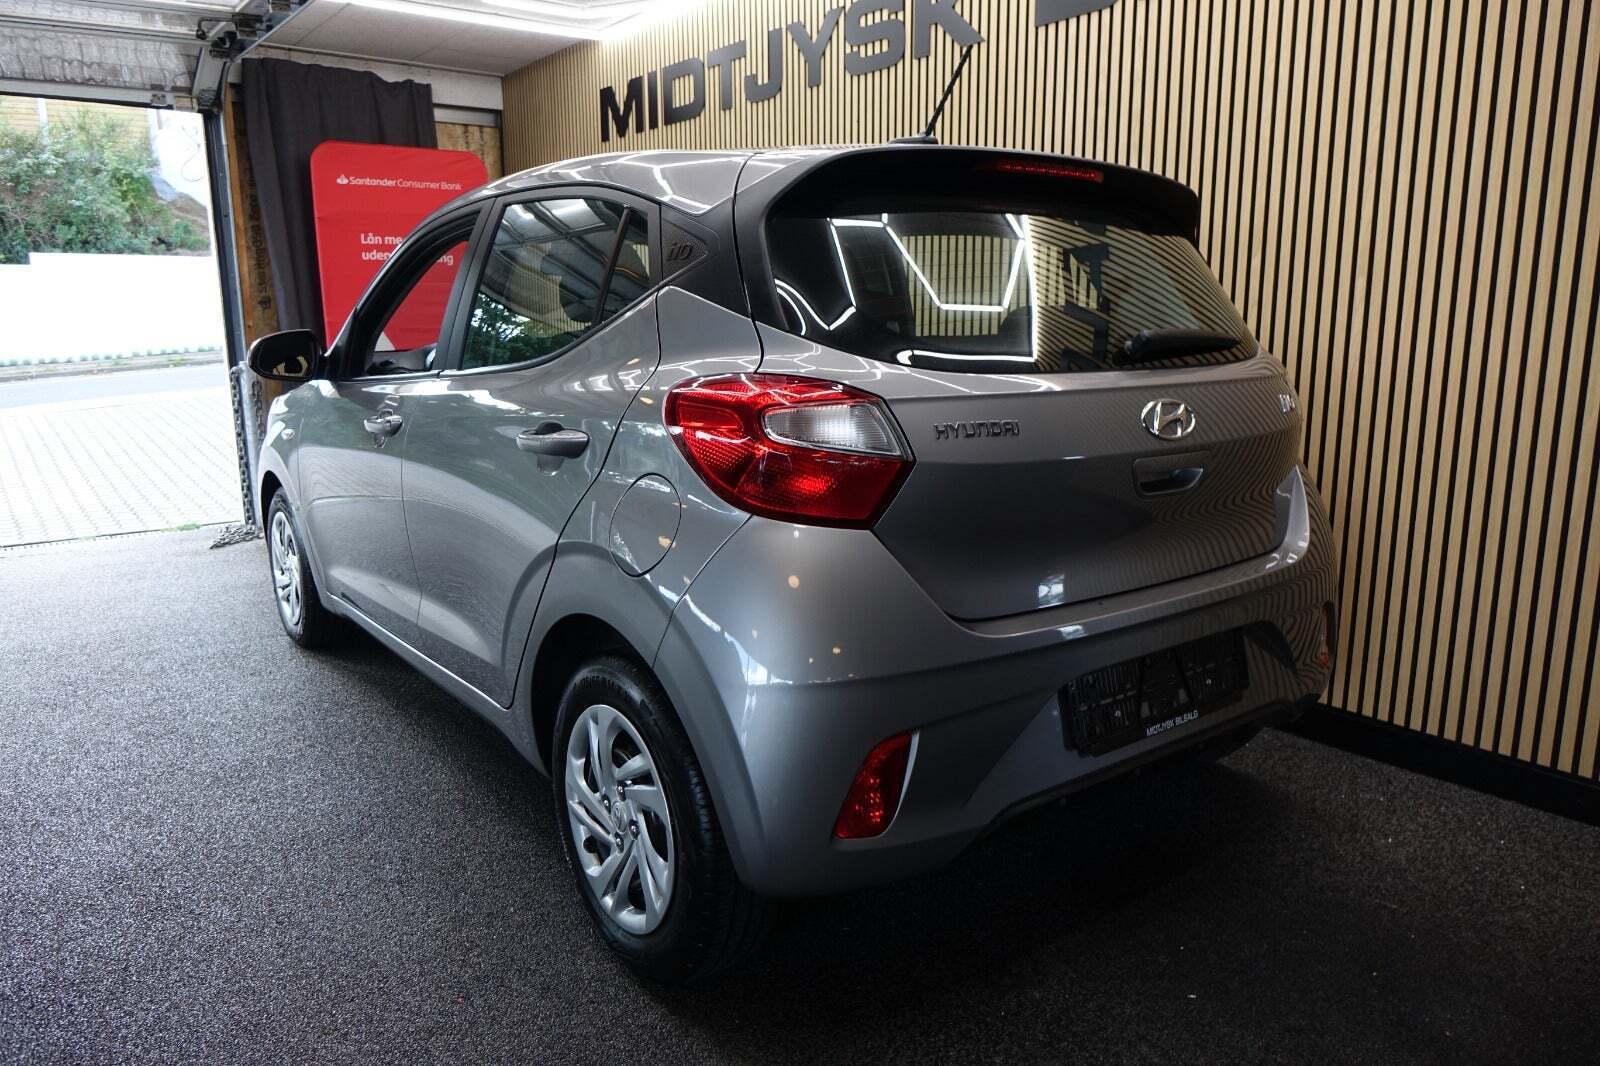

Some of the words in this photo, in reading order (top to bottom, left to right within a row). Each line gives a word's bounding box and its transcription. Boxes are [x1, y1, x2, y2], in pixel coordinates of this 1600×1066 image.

[600, 0, 985, 142] MIDTJYSK
[349, 176, 396, 187] Santander
[397, 178, 440, 189] Consumer
[441, 181, 462, 191] Bank
[360, 232, 383, 244] Lån
[384, 236, 403, 244] me
[933, 419, 1020, 440] HYUNDAI
